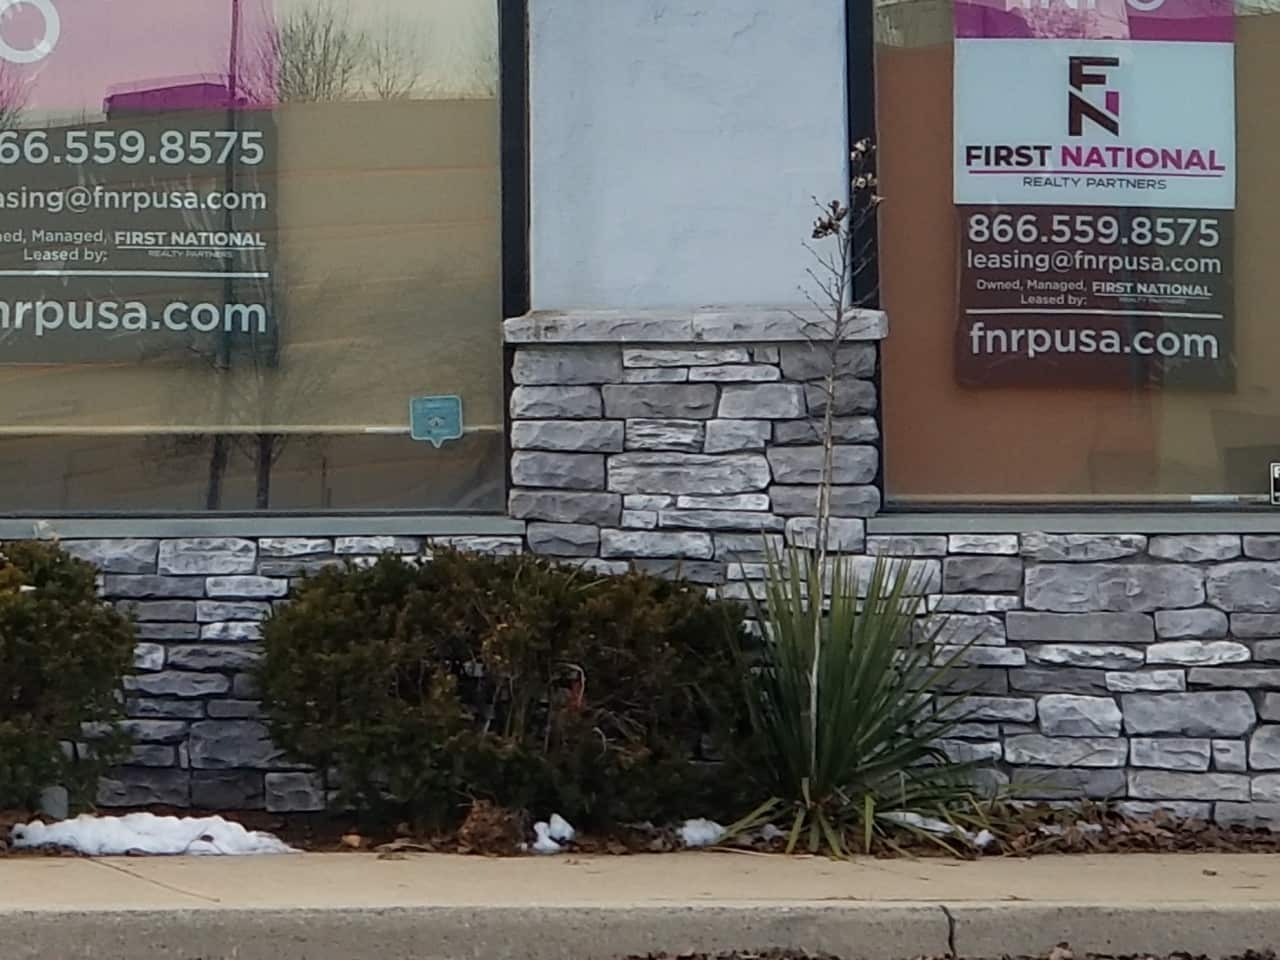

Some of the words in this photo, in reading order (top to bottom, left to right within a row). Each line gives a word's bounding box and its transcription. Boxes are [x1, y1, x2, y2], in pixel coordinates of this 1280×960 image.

[965, 145, 1053, 167] FIRST
[1061, 145, 1226, 171] NATIONAL
[1023, 176, 1081, 188] REALTY
[1086, 177, 1167, 190] PARTNERS
[31, 229, 107, 244] Managed,
[968, 213, 1220, 247] 866.559.8575
[114, 231, 168, 245] FIRST
[171, 231, 267, 246] NATIONAL
[23, 247, 79, 261] Leased
[967, 248, 1222, 273] leasing@fnrpusa.com
[976, 279, 1024, 291] Owned,
[1027, 279, 1087, 292] Managed,
[1092, 281, 1134, 293] FIRST
[1136, 282, 1213, 297] NATIONAL
[1021, 294, 1064, 305] Leased
[969, 321, 1220, 359] fnrpusa.com
